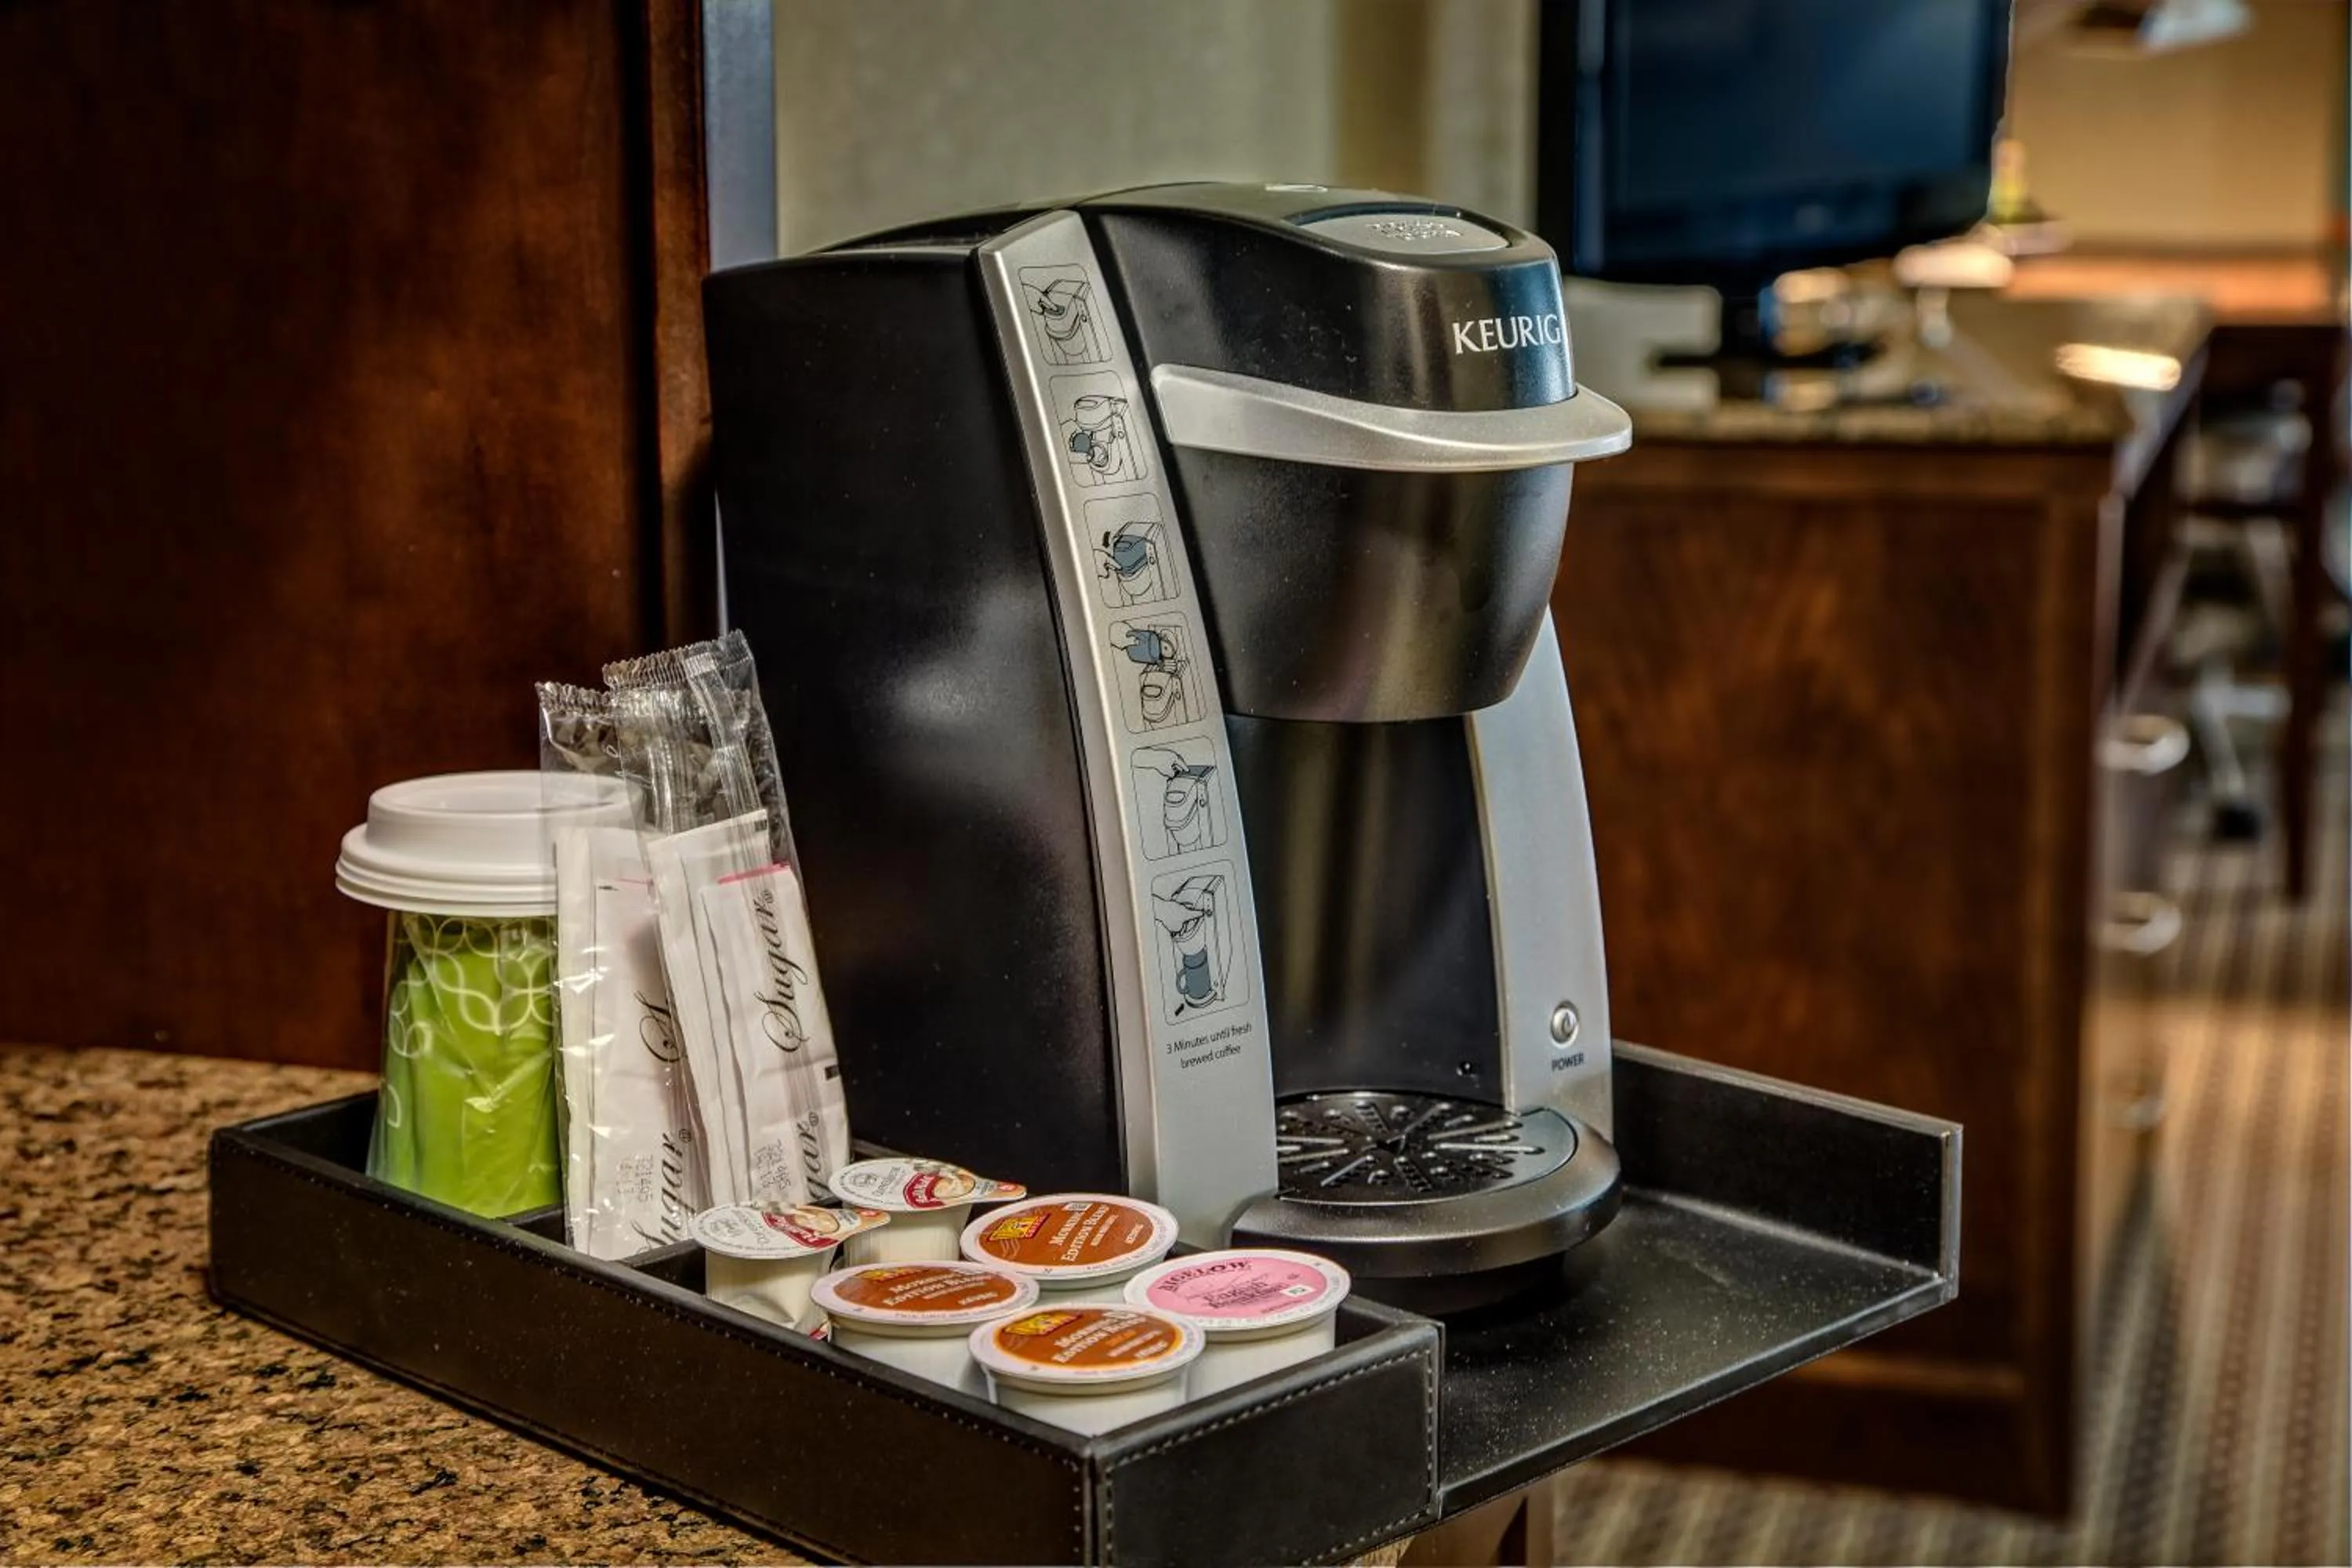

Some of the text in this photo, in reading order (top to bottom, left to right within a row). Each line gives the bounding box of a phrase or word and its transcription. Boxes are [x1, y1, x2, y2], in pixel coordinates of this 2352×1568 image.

[1452, 314, 1563, 354] KEURIG
[753, 898, 810, 1052] Sugar
[1166, 1022, 1252, 1054] 3 Minutes until fresh
[1180, 1044, 1241, 1069] brewed coffee
[1551, 1053, 1584, 1072] POWER
[797, 1120, 830, 1200] gar
